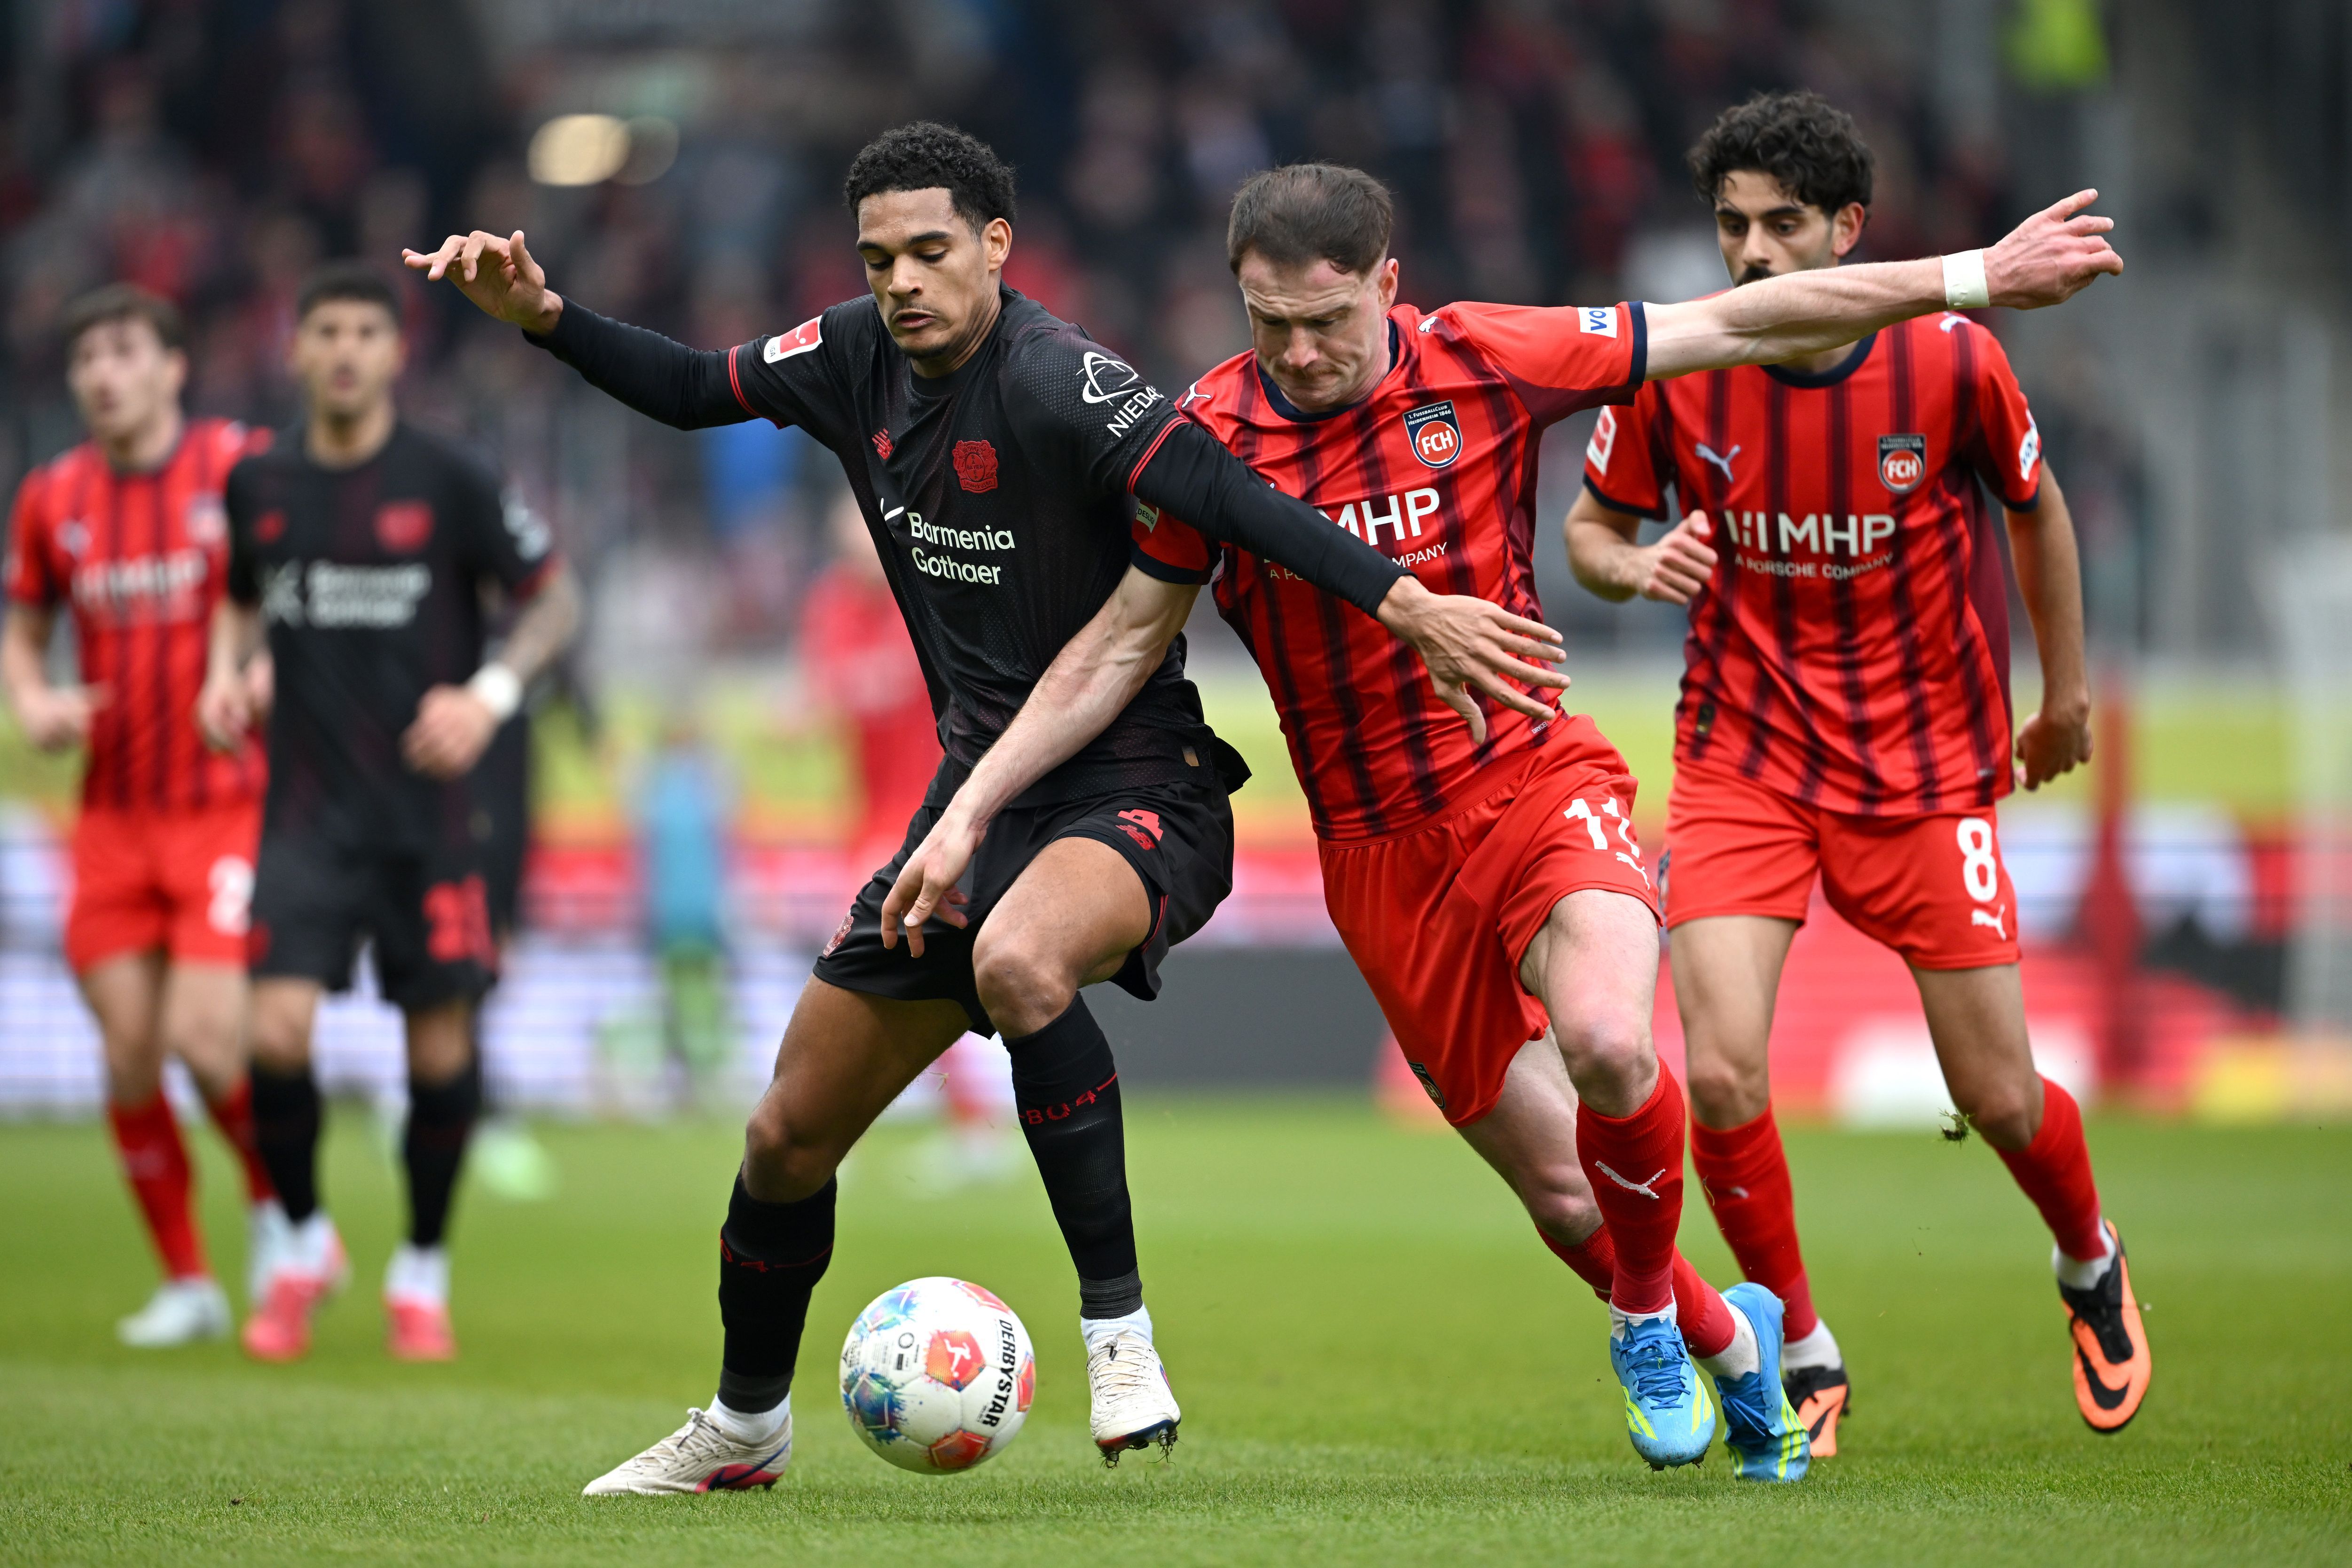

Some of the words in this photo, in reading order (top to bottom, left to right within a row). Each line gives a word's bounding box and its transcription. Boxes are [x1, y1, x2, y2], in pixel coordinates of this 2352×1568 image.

[1588, 307, 1607, 331] VO
[1421, 430, 1454, 455] FCH
[1888, 459, 1918, 479] FCH
[907, 512, 1015, 550] Barmenia
[1778, 512, 1896, 557] MHP
[911, 547, 1001, 585] Gothaer
[1392, 541, 1448, 568] MPANY
[1746, 557, 1818, 578] PORSCHE
[1822, 552, 1894, 580] COMPANY
[1956, 817, 1998, 902] 8
[982, 1319, 1016, 1427] DERBYSTAR
